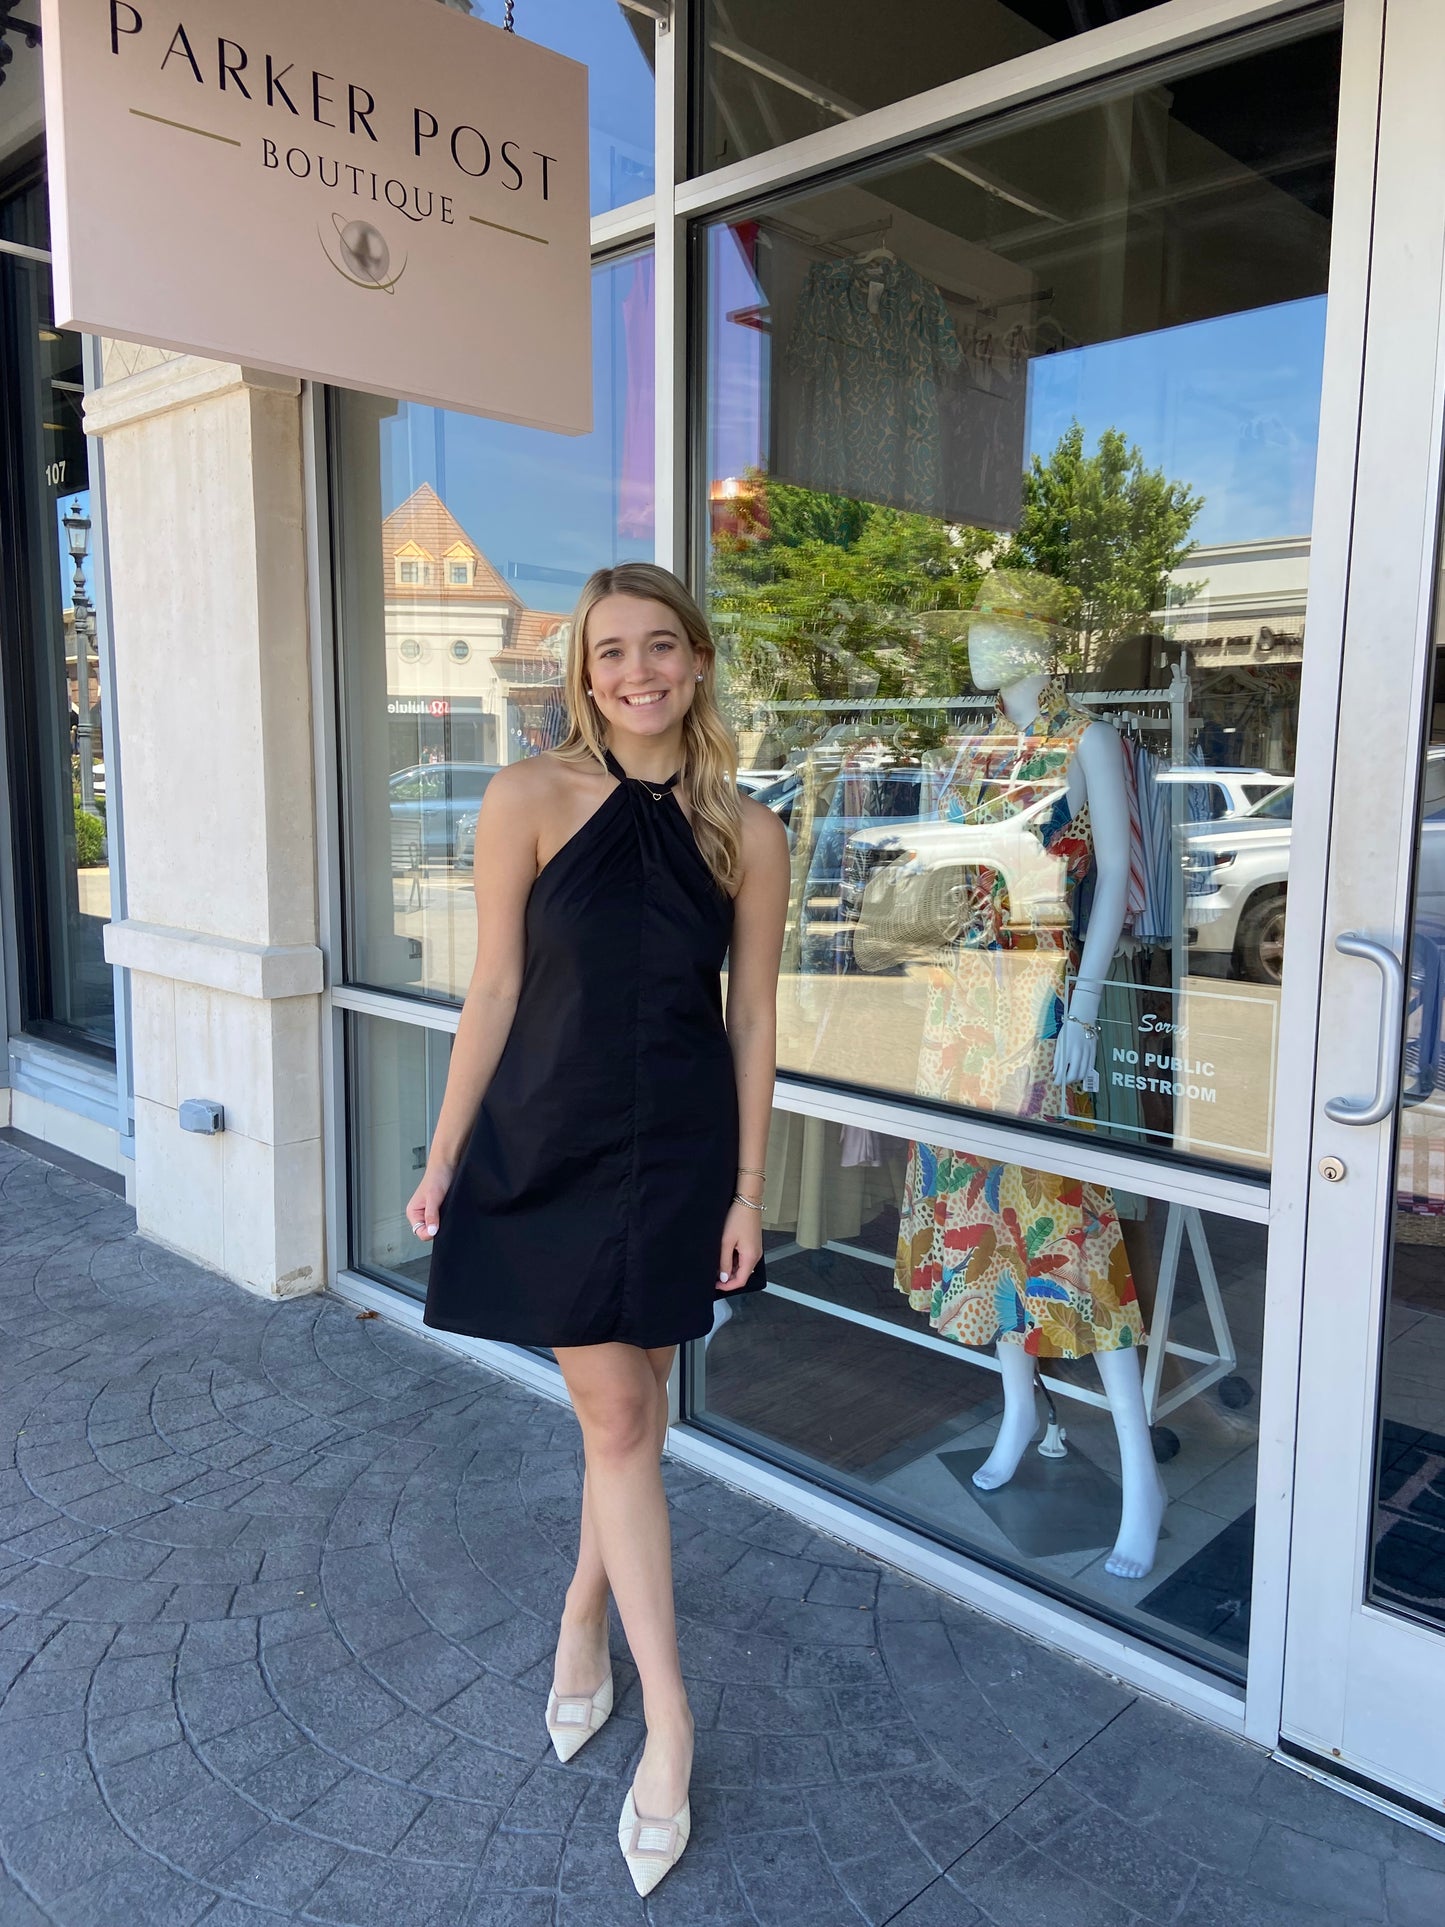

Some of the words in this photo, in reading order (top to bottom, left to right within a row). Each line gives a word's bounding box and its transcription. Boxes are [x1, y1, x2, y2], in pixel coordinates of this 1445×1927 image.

[109, 0, 378, 142] PARKER
[413, 107, 557, 200] POST
[261, 137, 455, 225] BOUTIQUE
[45, 460, 66, 486] 107
[1138, 1014, 1189, 1040] Sorry
[1112, 1047, 1139, 1065] NO
[1144, 1053, 1215, 1076] PUBLIC
[1112, 1072, 1216, 1103] RESTROOM
